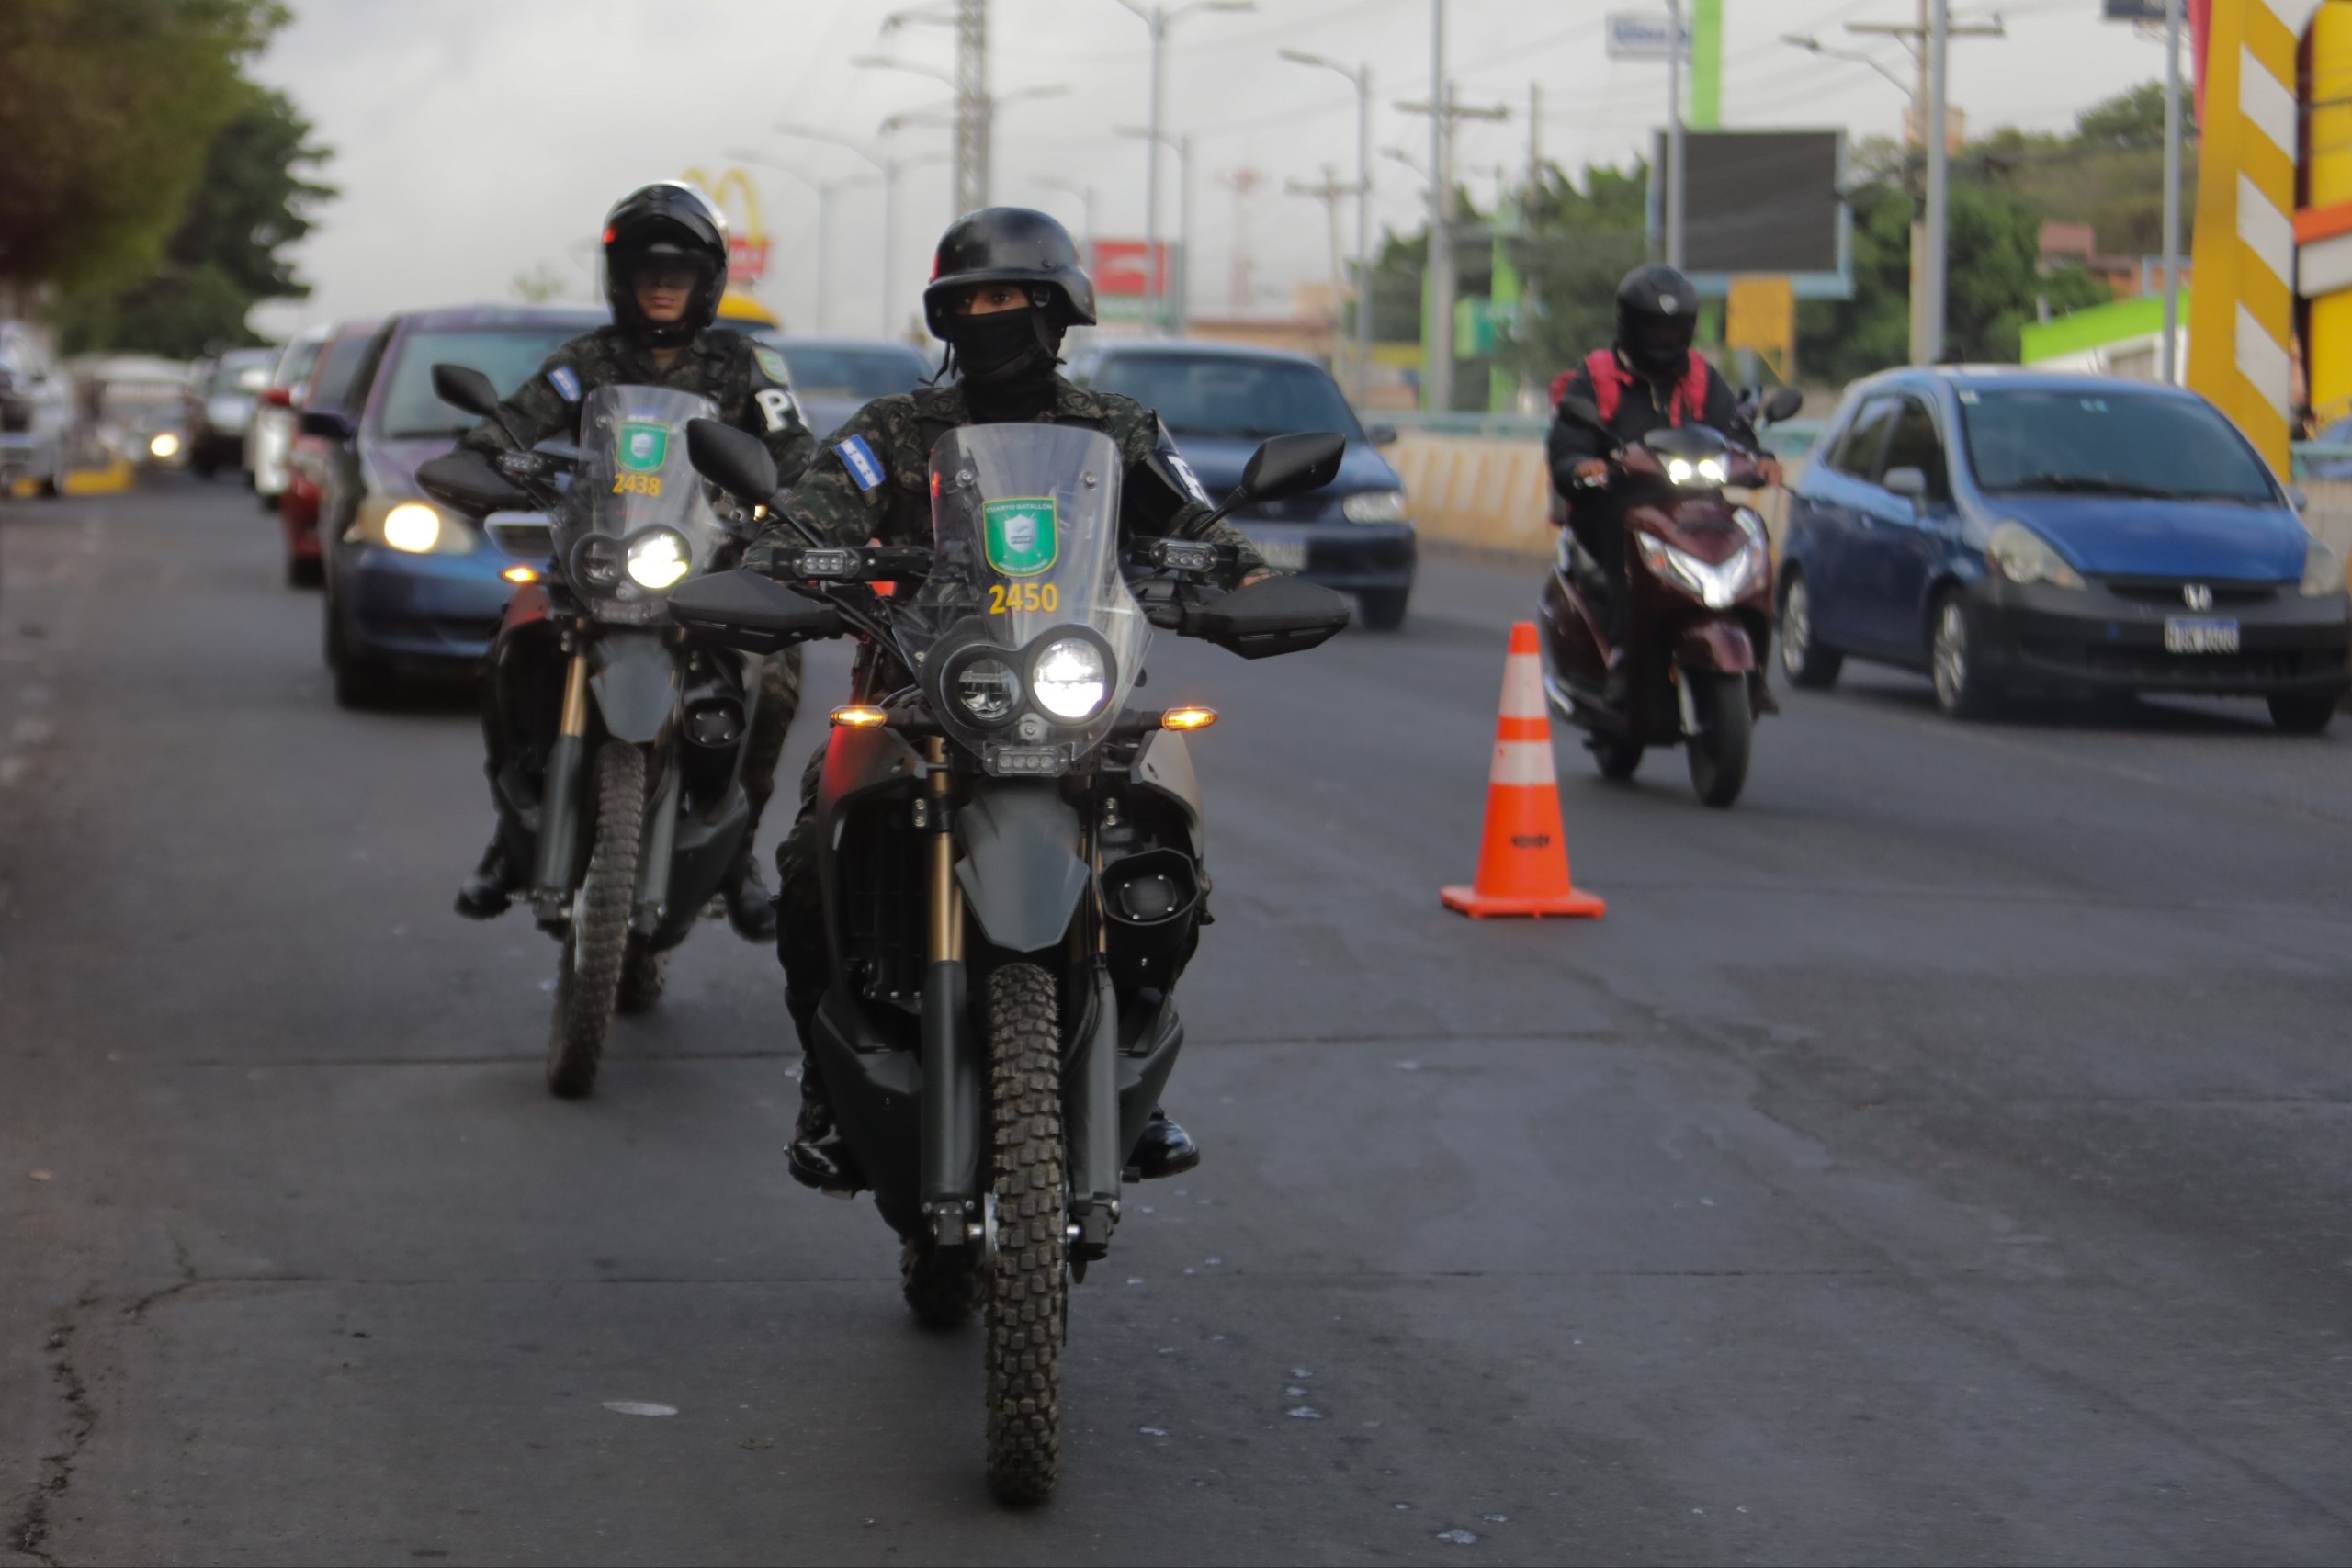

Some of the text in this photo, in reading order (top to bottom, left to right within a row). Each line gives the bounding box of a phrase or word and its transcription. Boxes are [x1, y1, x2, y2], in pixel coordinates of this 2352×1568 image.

[612, 473, 662, 497] 2438
[986, 504, 1014, 513] CUARTO
[989, 582, 1058, 615] 2450
